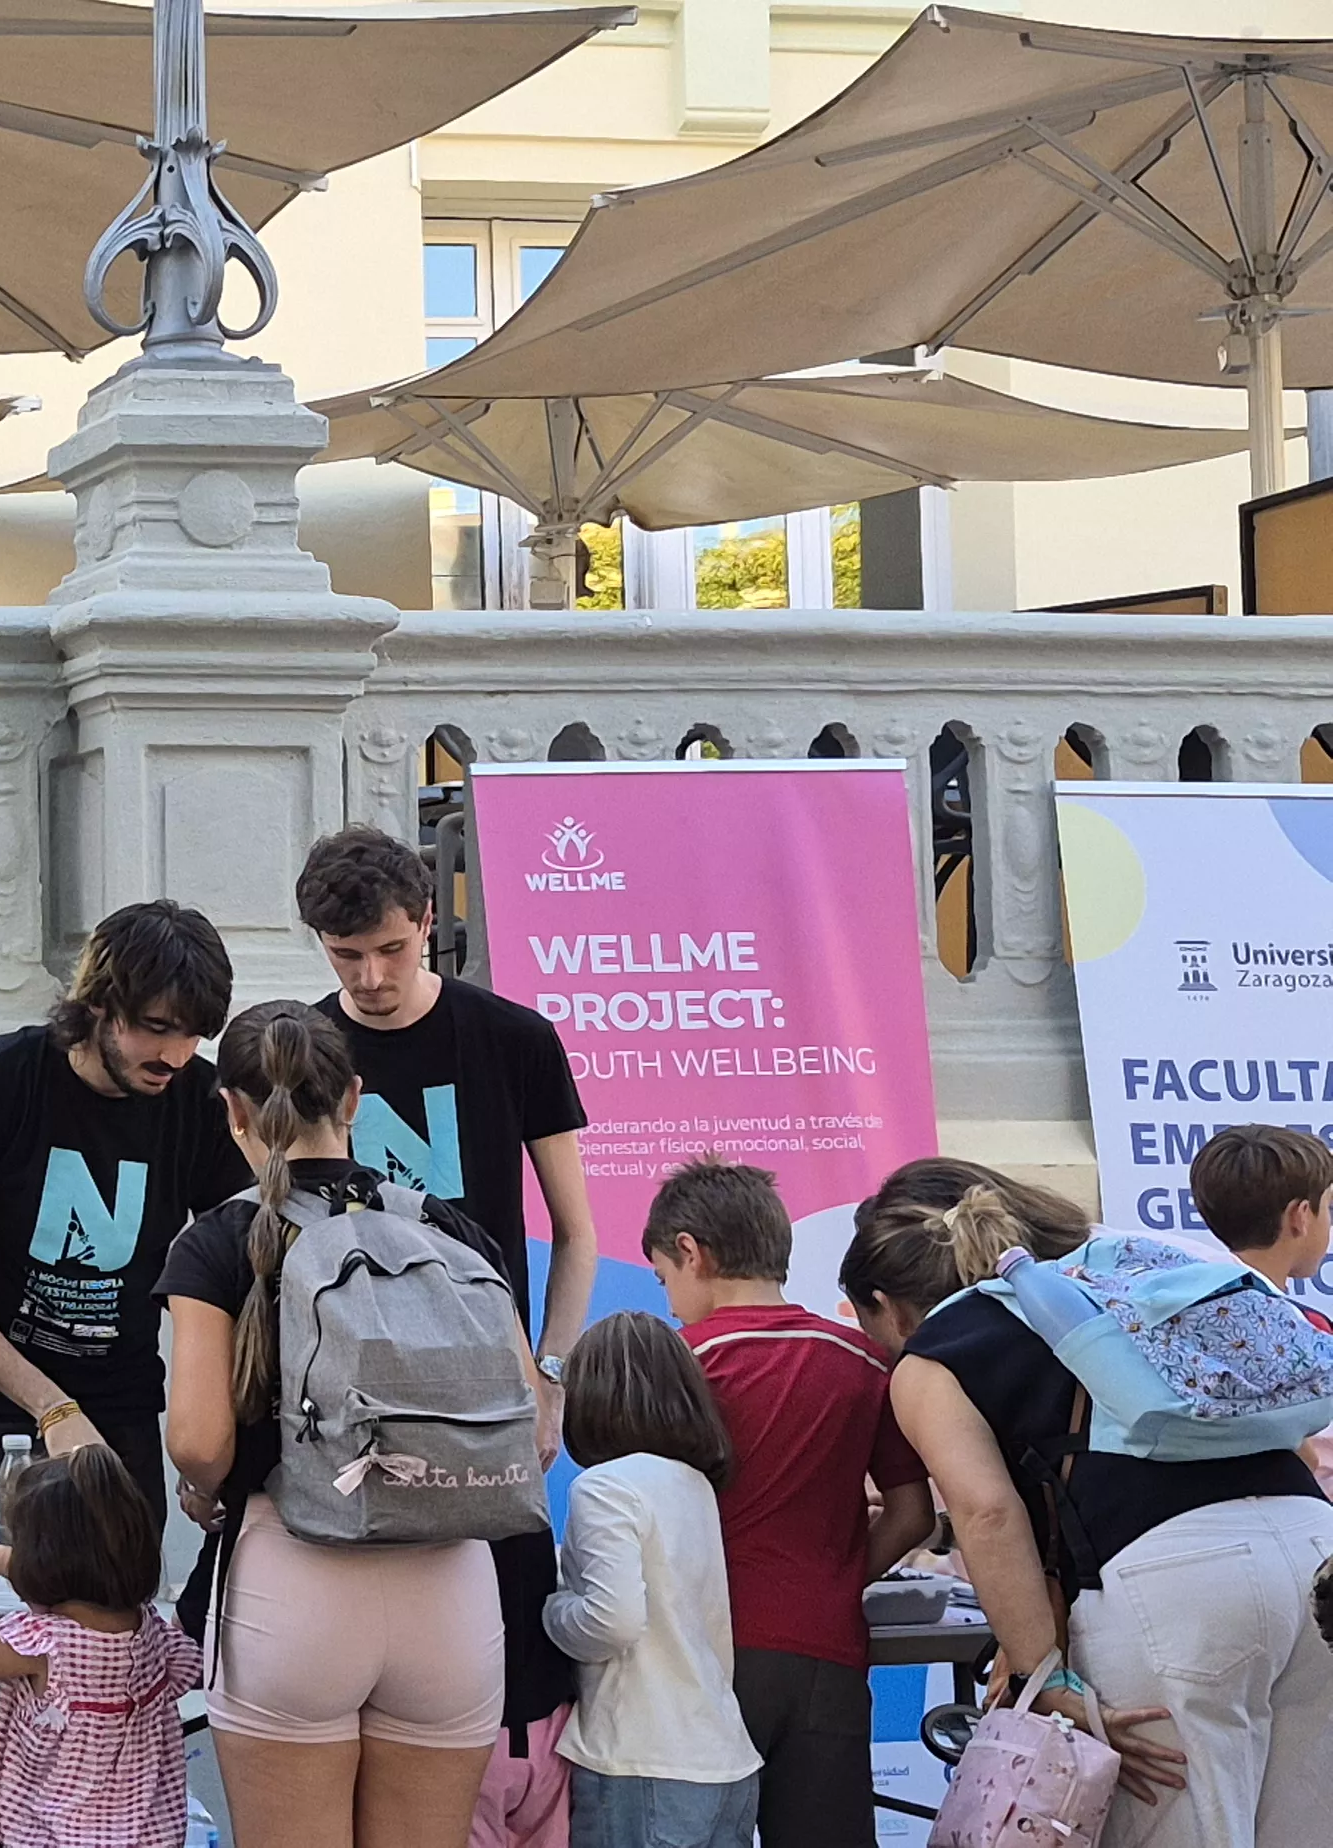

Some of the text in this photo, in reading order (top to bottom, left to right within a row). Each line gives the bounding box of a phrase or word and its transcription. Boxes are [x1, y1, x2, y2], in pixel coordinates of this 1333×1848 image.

[524, 871, 626, 892] WELLME
[528, 931, 760, 975] WELLME
[536, 988, 786, 1032] PROJECT:
[567, 1045, 877, 1081] OUTH WELLBEING
[351, 1083, 465, 1199] N
[577, 1118, 676, 1138] poderando
[679, 1120, 691, 1133] a
[693, 1115, 709, 1133] la
[712, 1113, 791, 1136] juventud
[795, 1117, 807, 1130] a
[712, 1133, 809, 1153] emocional,
[812, 1131, 867, 1152] social,
[646, 1162, 657, 1180] y
[29, 1146, 148, 1272] N
